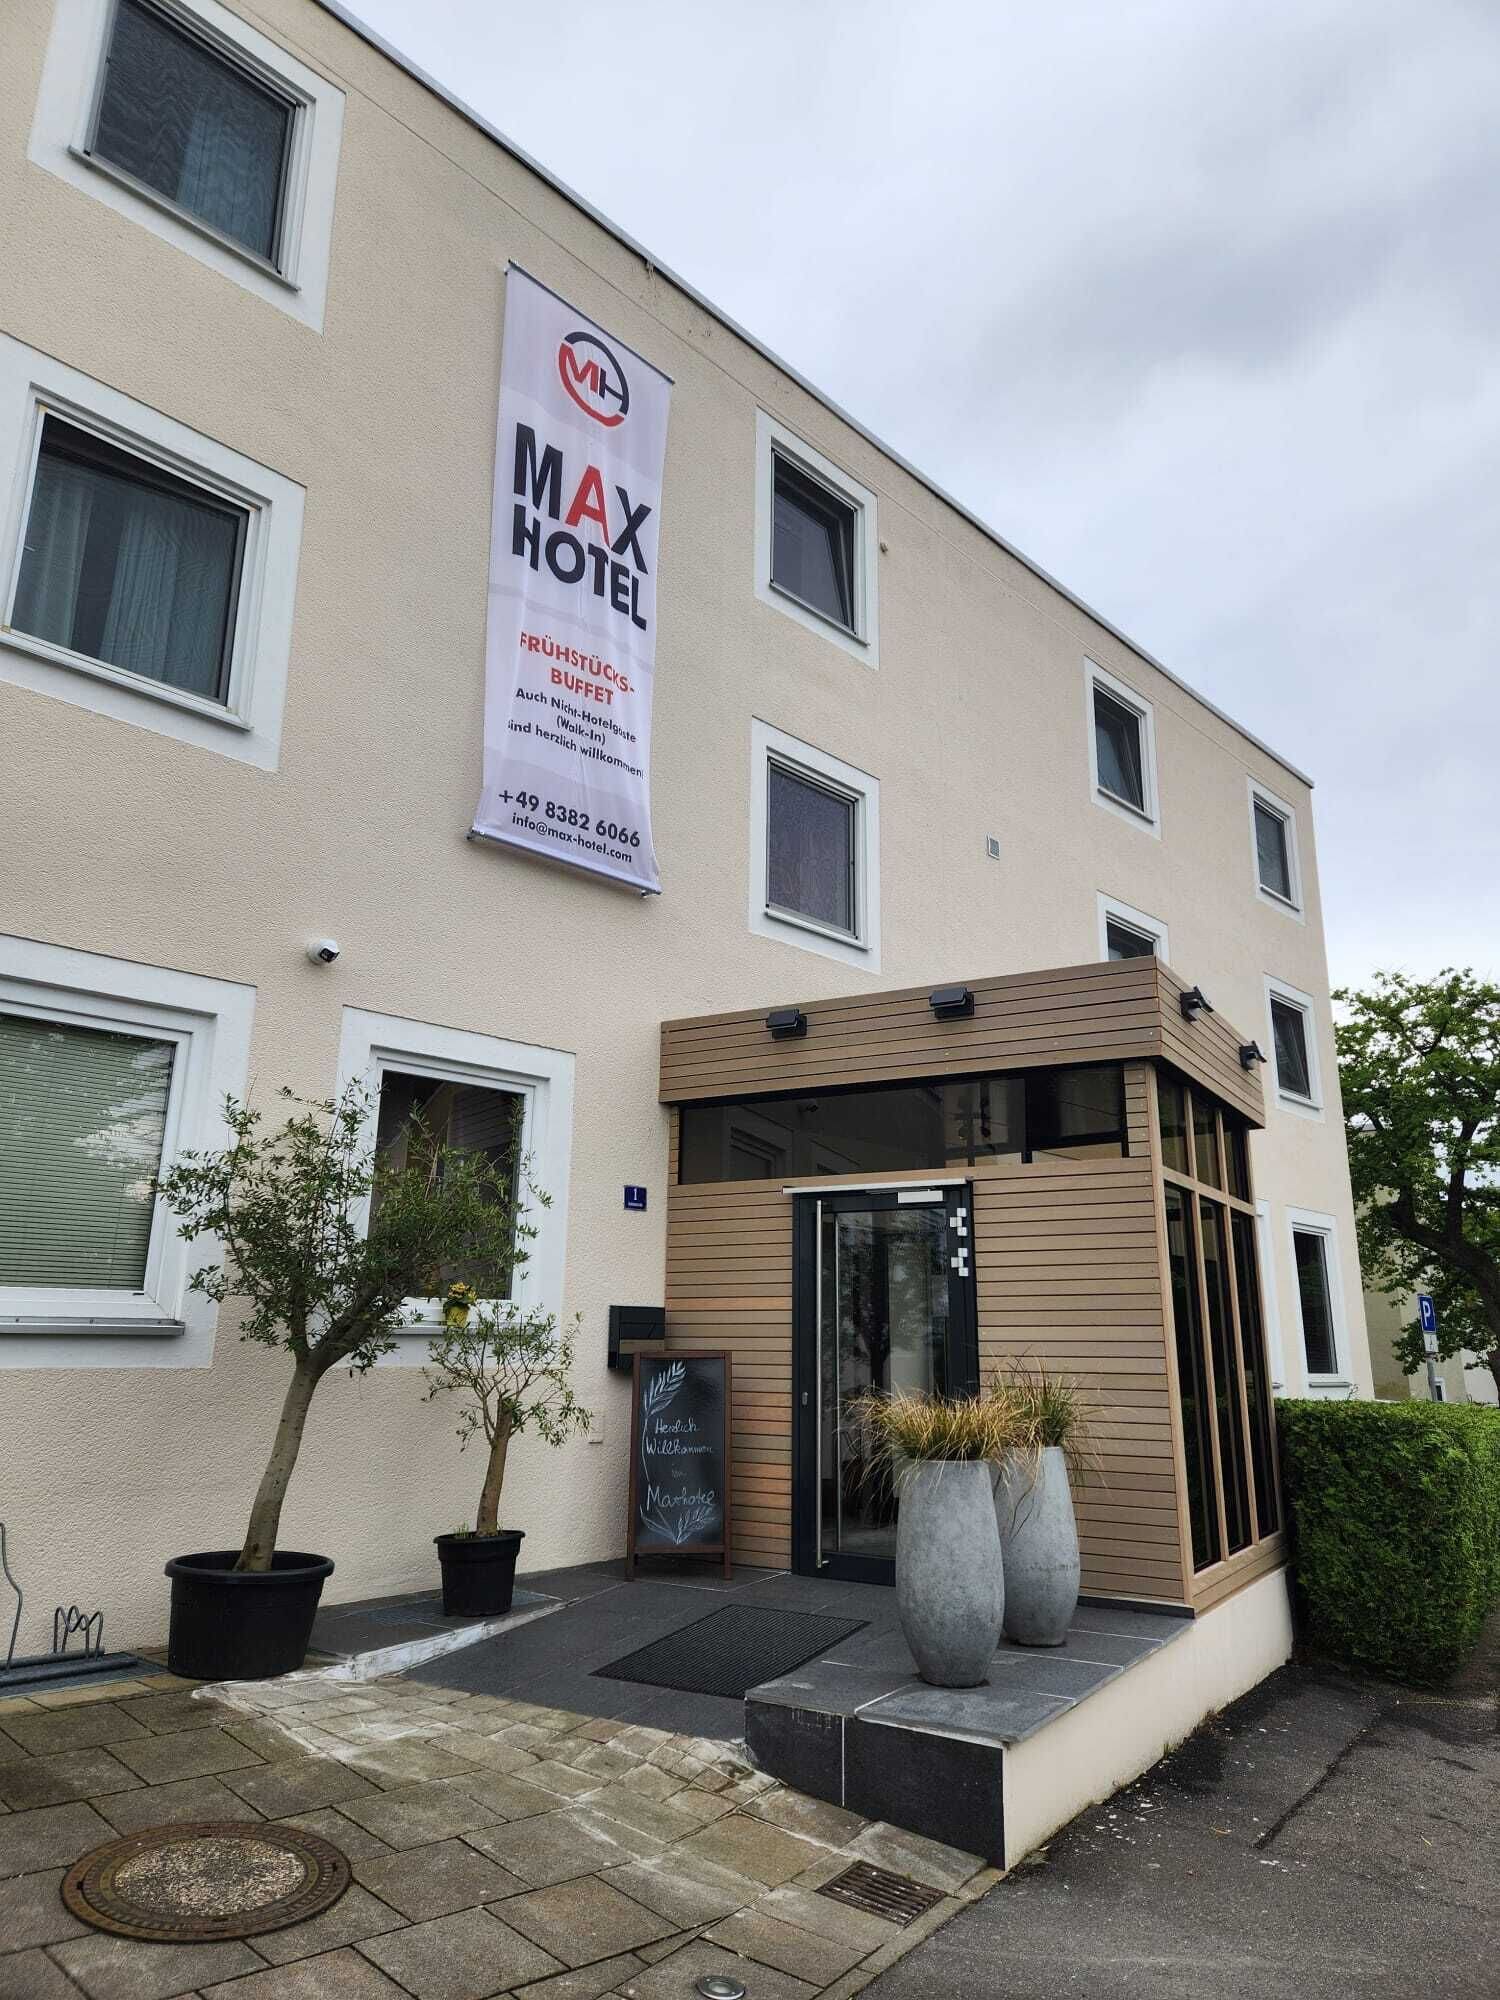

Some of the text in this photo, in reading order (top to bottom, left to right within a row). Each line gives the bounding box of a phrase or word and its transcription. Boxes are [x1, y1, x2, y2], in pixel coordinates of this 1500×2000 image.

[513, 422, 652, 574] MAX
[512, 504, 647, 630] HOTEL
[520, 632, 634, 693] FRÜHSTÜCKS-
[516, 688, 547, 703] Auch
[551, 667, 613, 705] BUFFET
[535, 725, 577, 751] herzlich
[556, 715, 606, 745] (Walk-In)
[499, 790, 640, 847] +49 8382 6066
[512, 812, 632, 863] info@max-hotel.com
[1422, 1300, 1431, 1327] P
